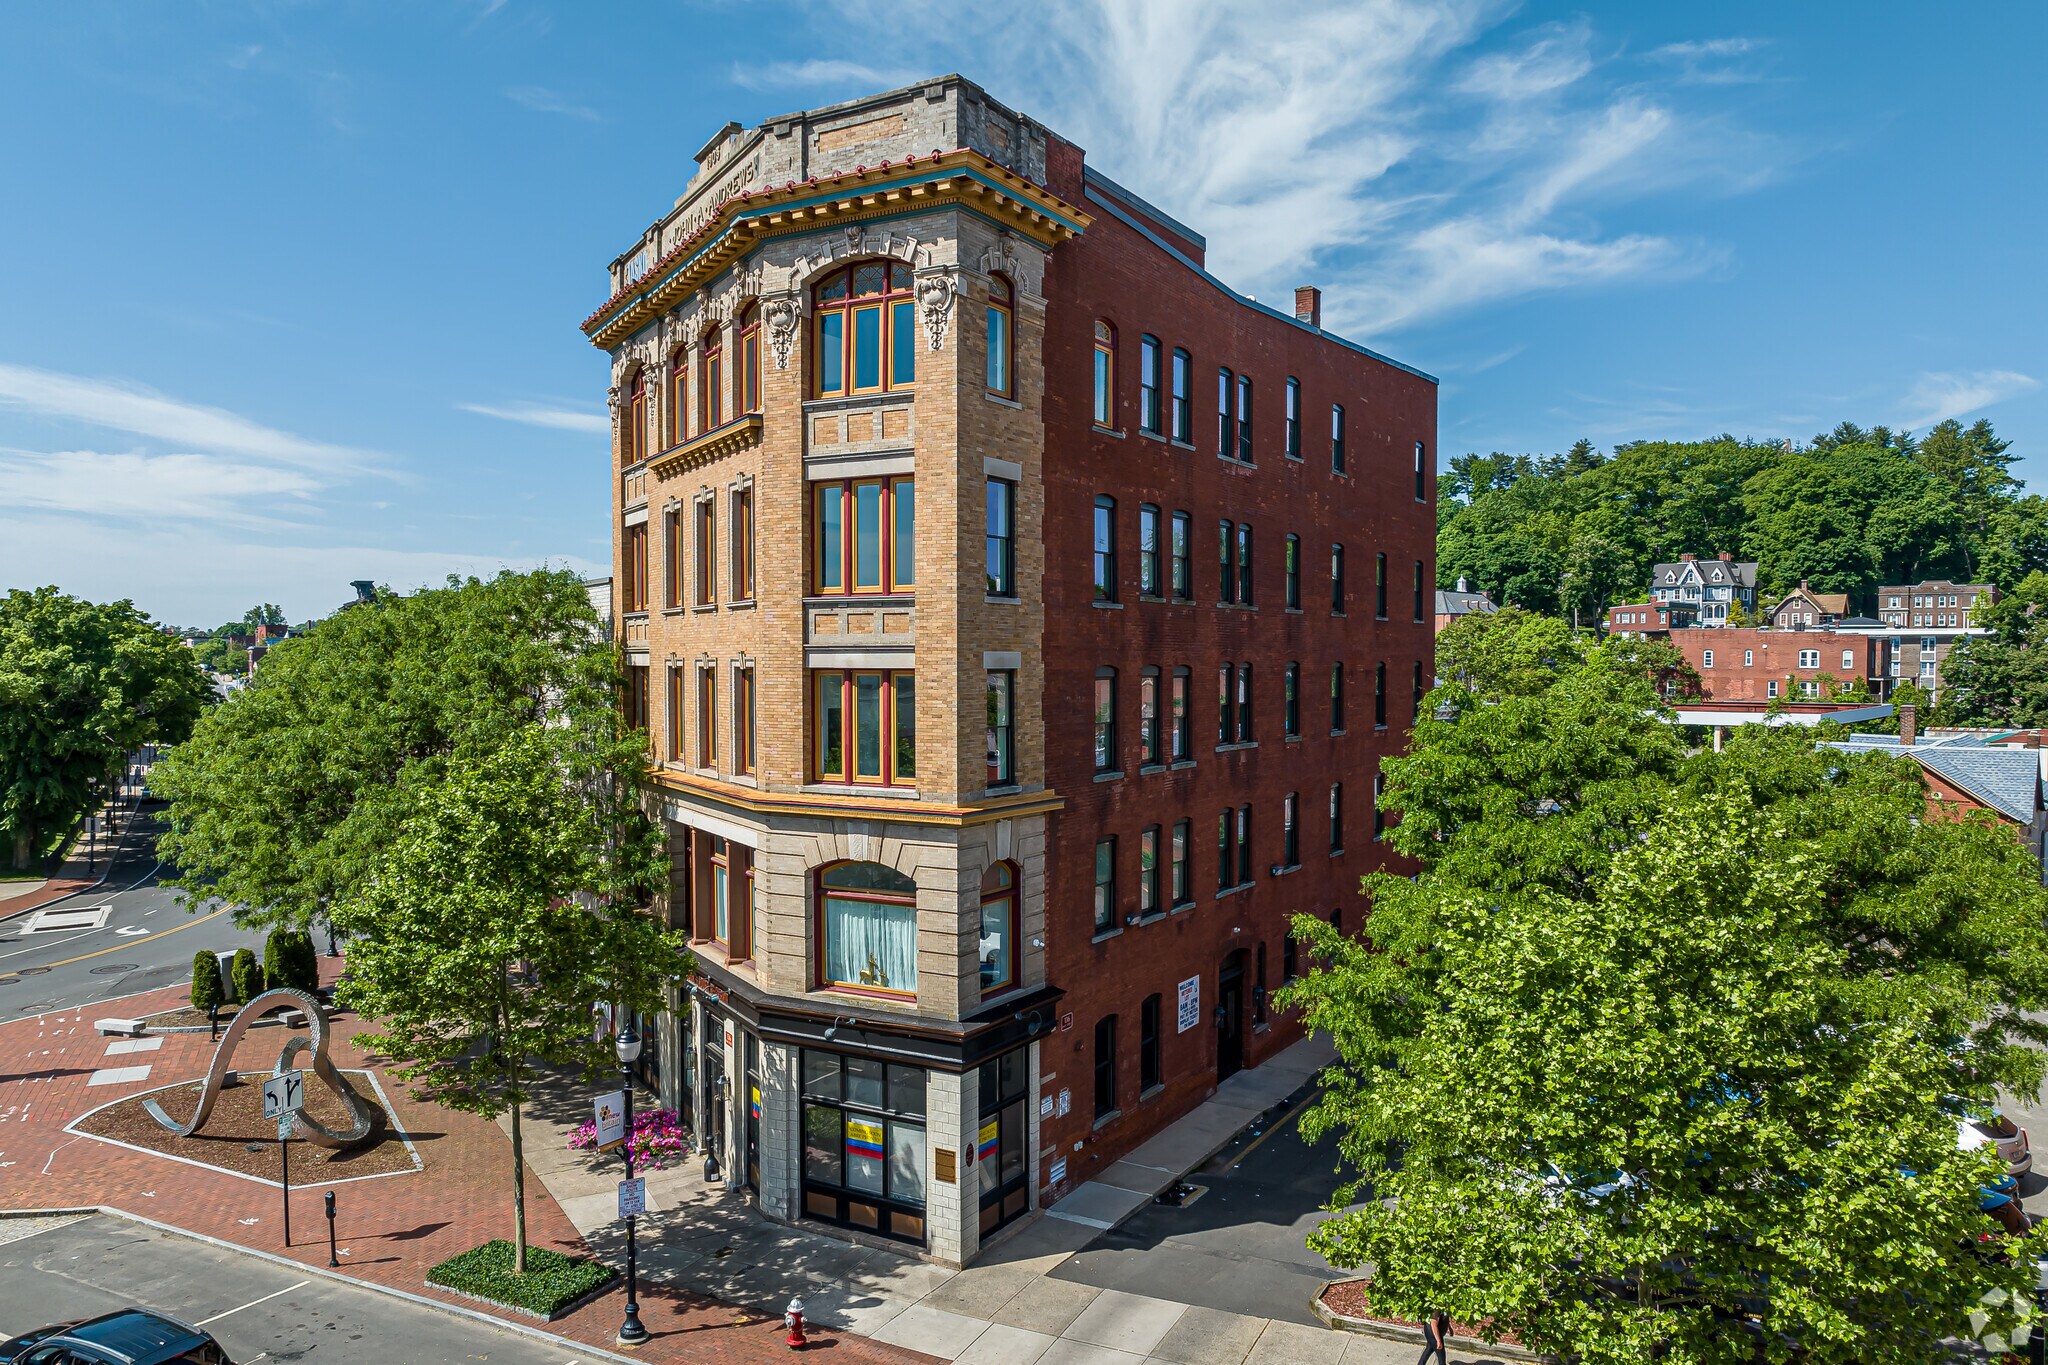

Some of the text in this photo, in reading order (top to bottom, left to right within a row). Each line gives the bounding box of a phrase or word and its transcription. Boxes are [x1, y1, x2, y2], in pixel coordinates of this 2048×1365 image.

[672, 162, 754, 244] JOHN A ANDREWS
[1180, 980, 1194, 990] WELCOME
[266, 1106, 282, 1117] ONLY
[608, 1111, 621, 1120] new
[602, 1118, 621, 1129] britain
[620, 1178, 644, 1186] EMERGENCY
